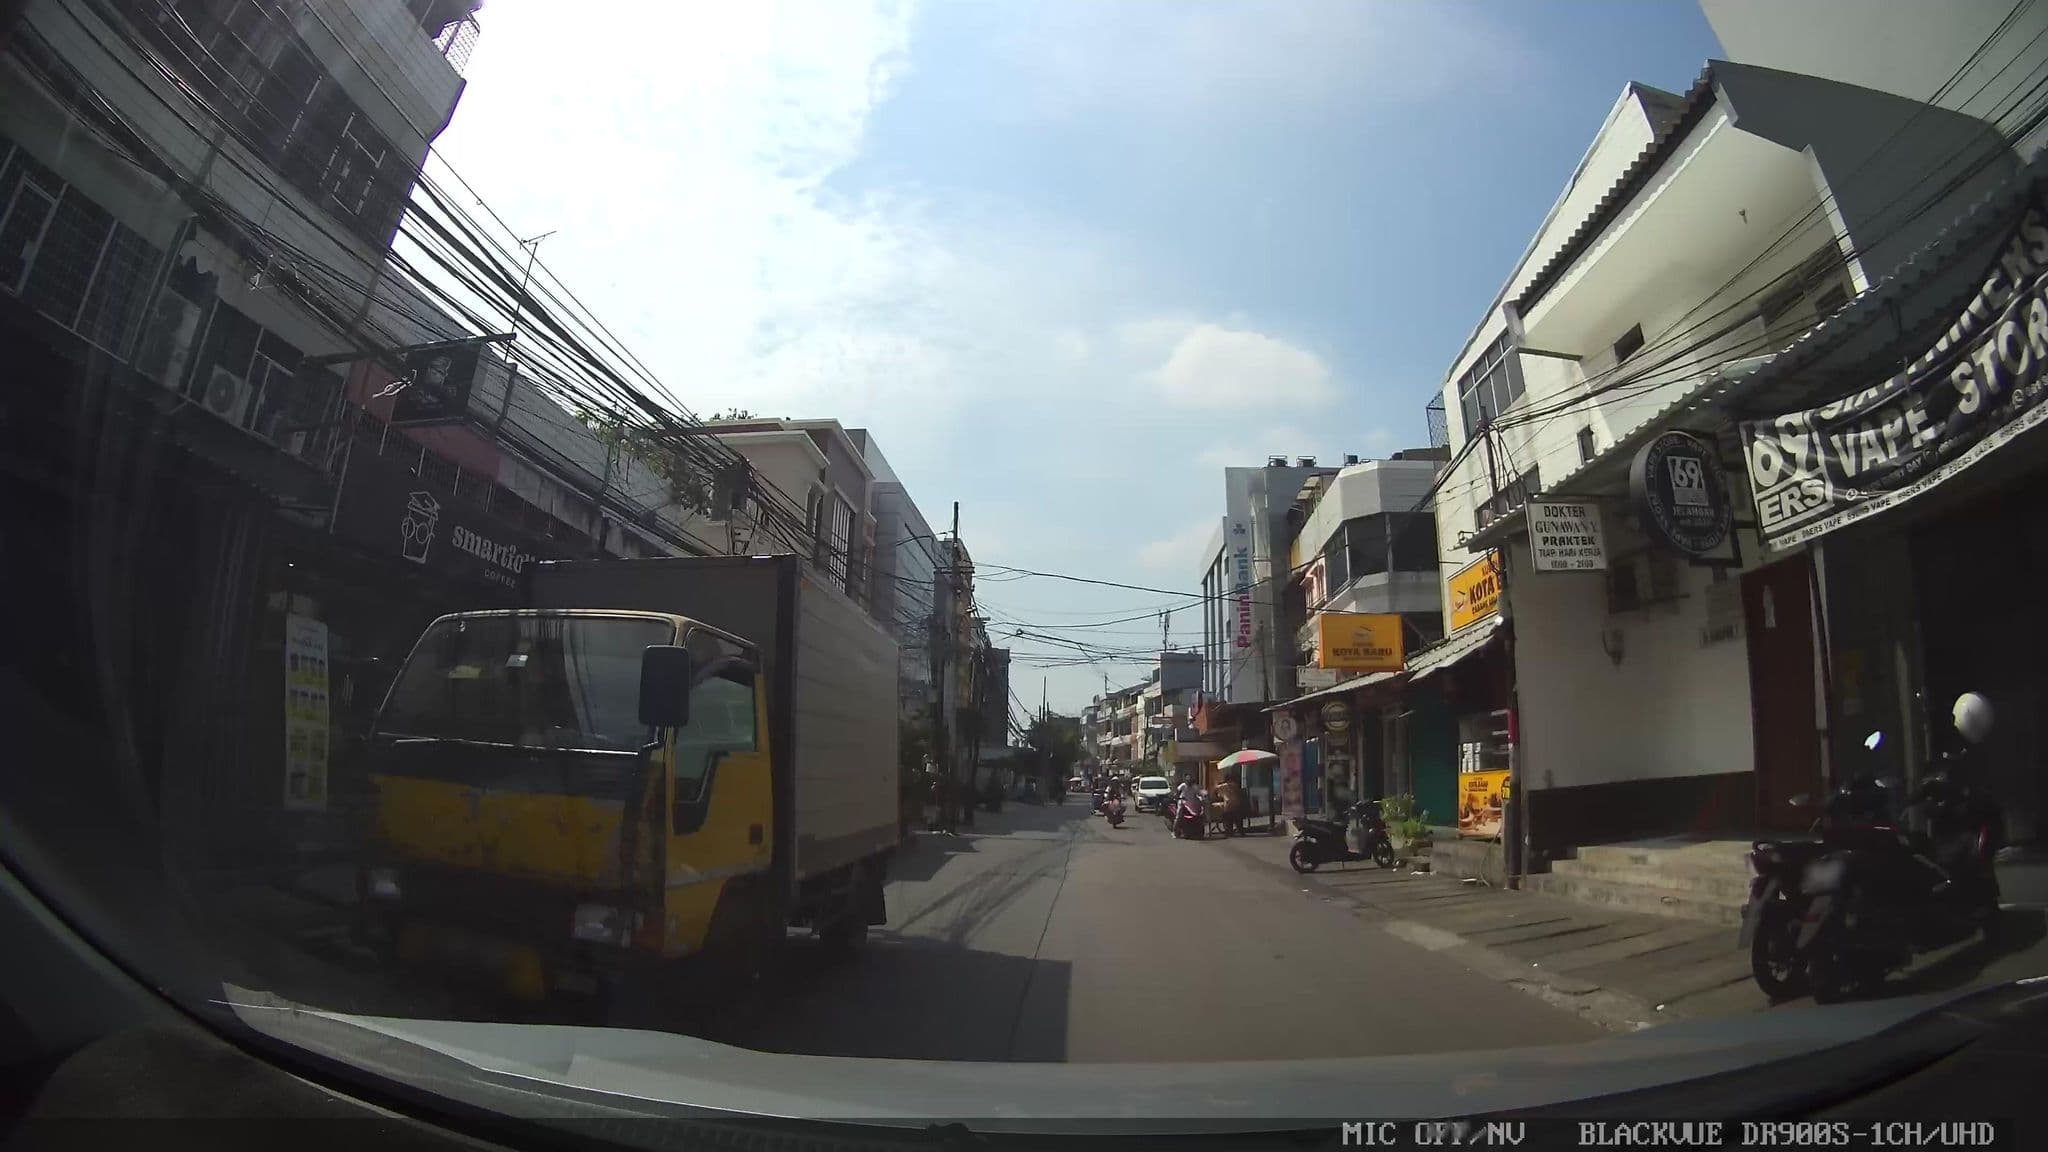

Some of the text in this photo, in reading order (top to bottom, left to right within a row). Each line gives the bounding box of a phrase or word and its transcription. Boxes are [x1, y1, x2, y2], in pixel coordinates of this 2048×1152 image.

[1829, 284, 2048, 478] VAPE STOR
[1673, 458, 1701, 488] 69
[1760, 479, 1825, 527] ERS
[1871, 499, 1892, 511] VAPE
[1543, 505, 1586, 518] DOKTER
[1542, 535, 1596, 547] PRAKTEK
[1558, 548, 1577, 558] HARI
[1469, 575, 1495, 605] KOTA
[1332, 647, 1361, 657] KOTA
